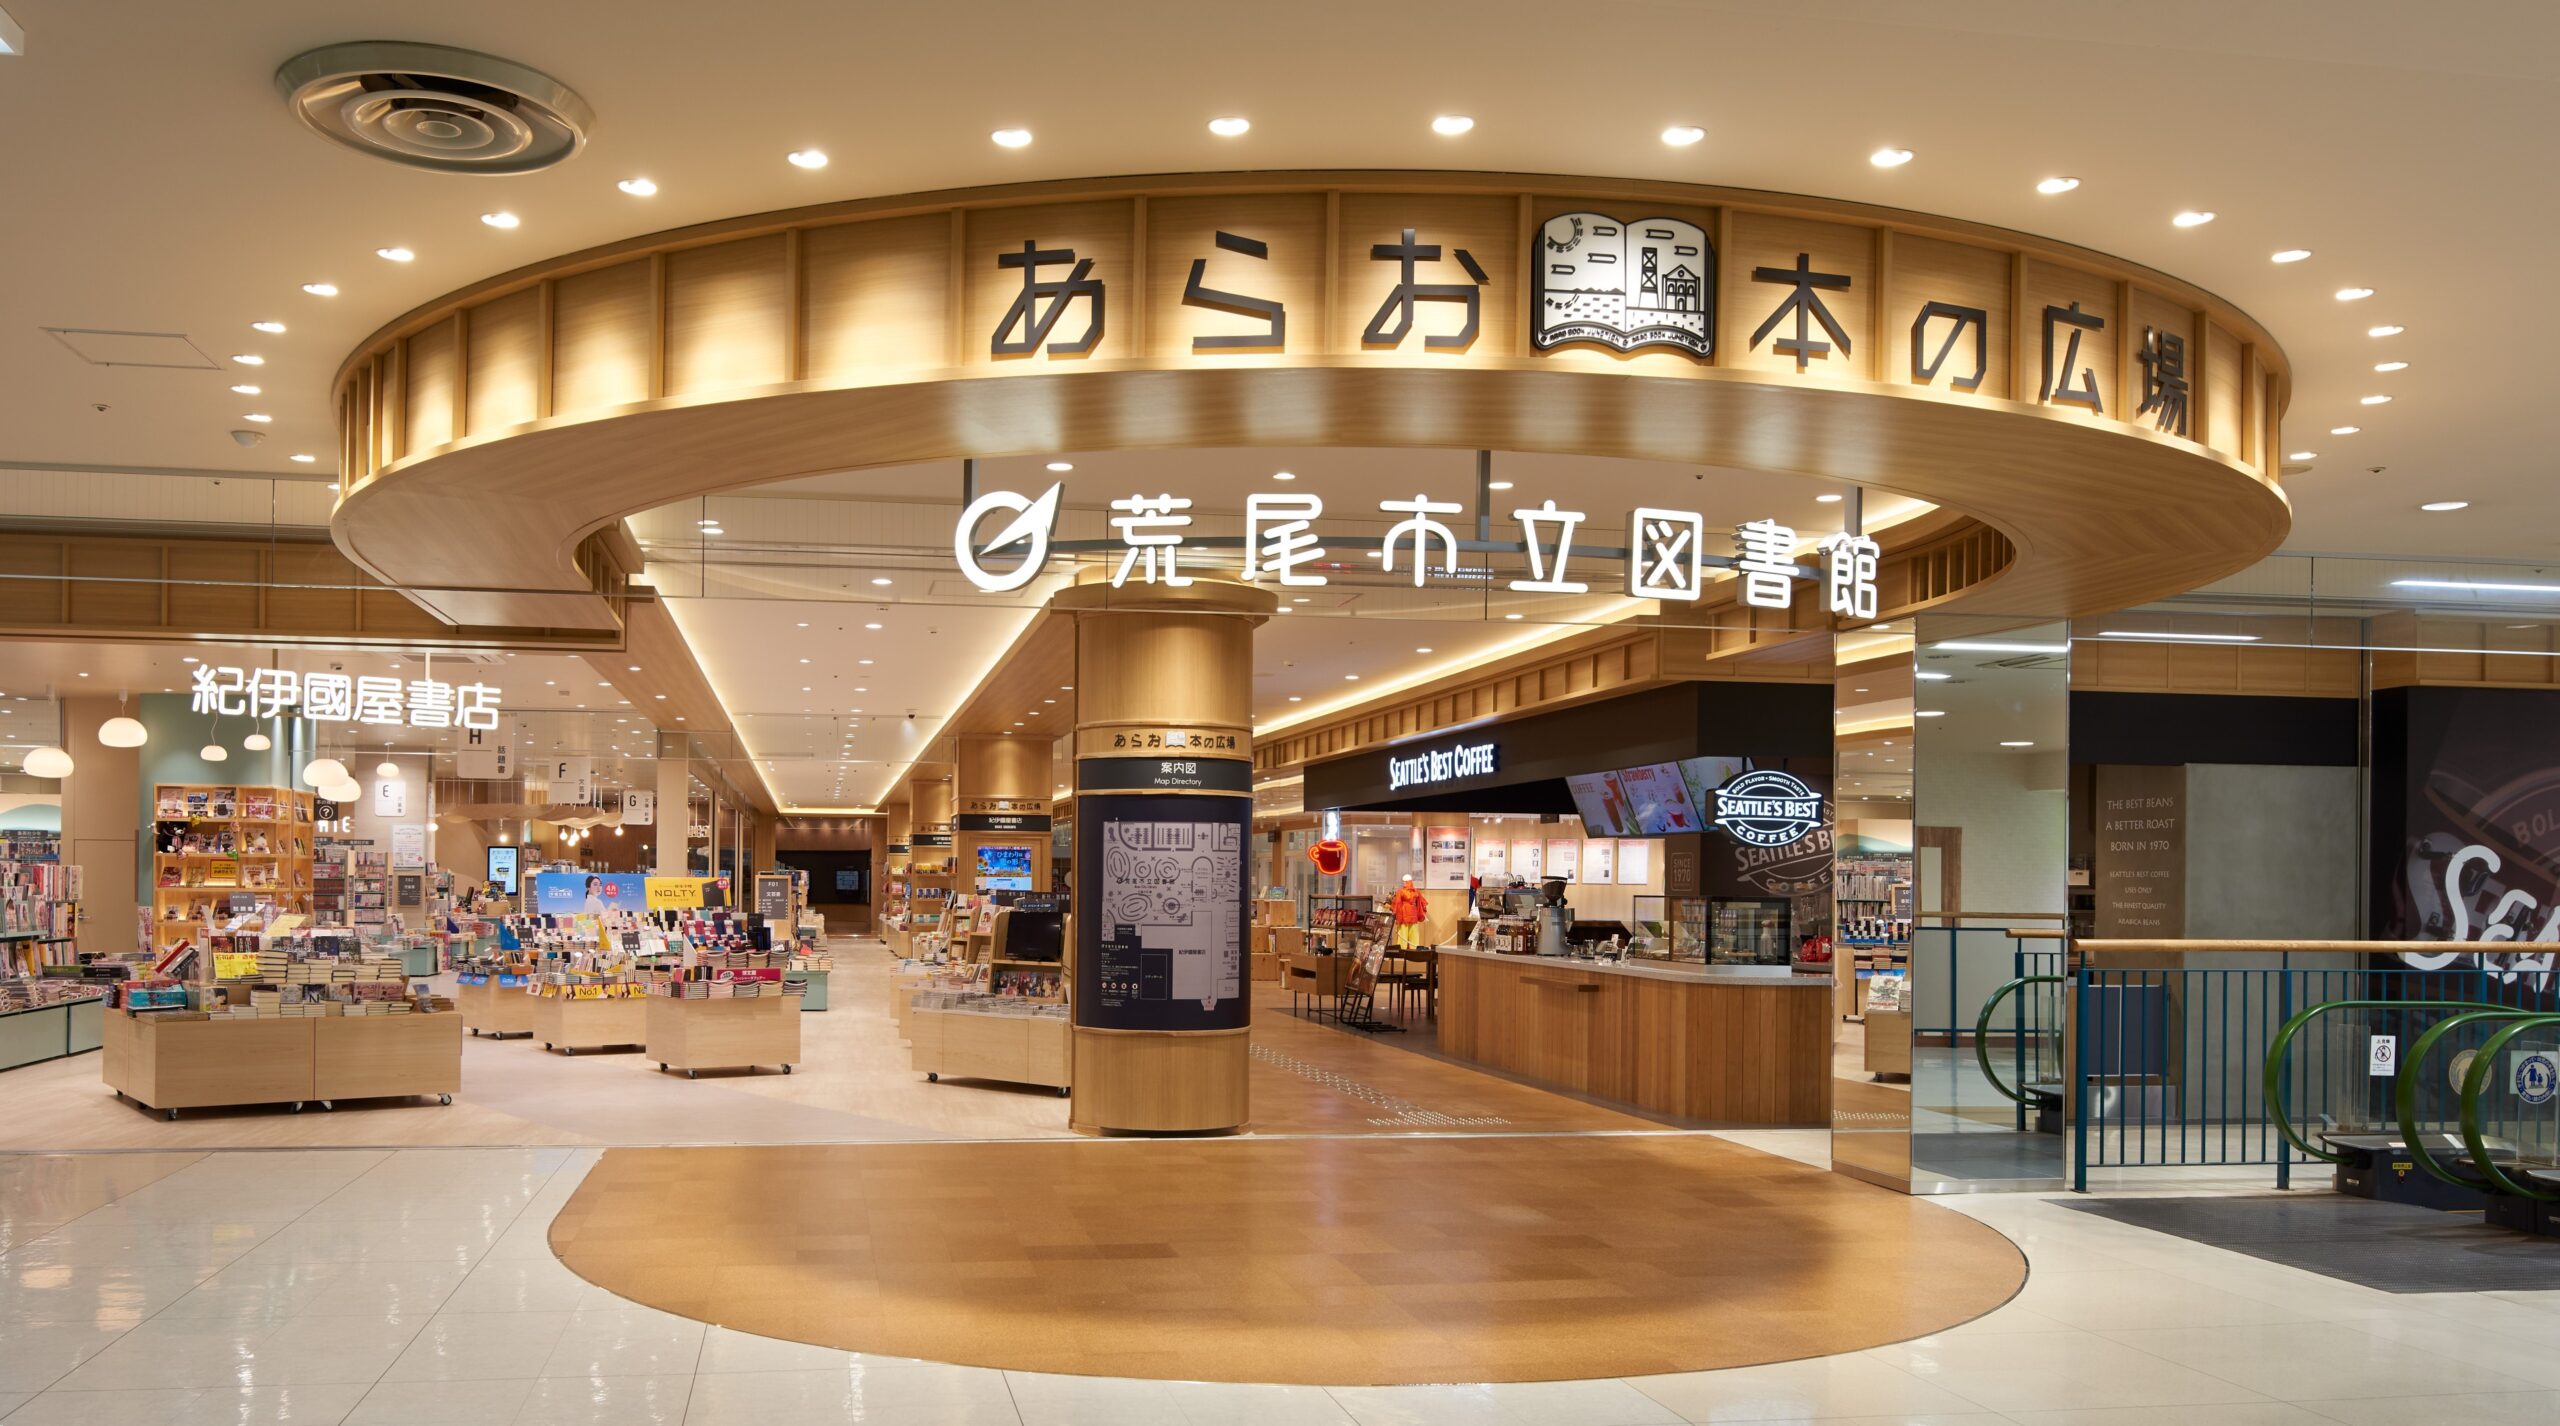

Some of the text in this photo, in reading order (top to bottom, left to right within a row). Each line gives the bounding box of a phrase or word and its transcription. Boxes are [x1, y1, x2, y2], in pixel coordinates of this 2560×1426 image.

[991, 229, 2188, 434] あらお 本の広場
[1110, 493, 1880, 619] 荒尾市立図書館
[192, 664, 502, 730] 紀伊國屋書店
[469, 728, 482, 744] H
[1114, 734, 1236, 750] あらお 本の広場
[1160, 762, 1197, 775] 案内図
[1430, 750, 1453, 782] BEST
[1454, 743, 1495, 778] COFFEE
[558, 762, 566, 779] F
[1154, 777, 1202, 787] Map Directory
[382, 784, 390, 798] E
[629, 794, 637, 807] G
[1717, 796, 1819, 818] SEATTLE'S BEST
[2107, 797, 2174, 810] THE BEST BEANS
[2105, 819, 2175, 831] A BETTER ROAST
[1736, 825, 1799, 844] COFFEE
[2110, 840, 2170, 852] BORN IN 1970
[1673, 869, 1691, 882] 1970
[654, 889, 696, 898] NOLTY
[579, 987, 598, 996] No.1
